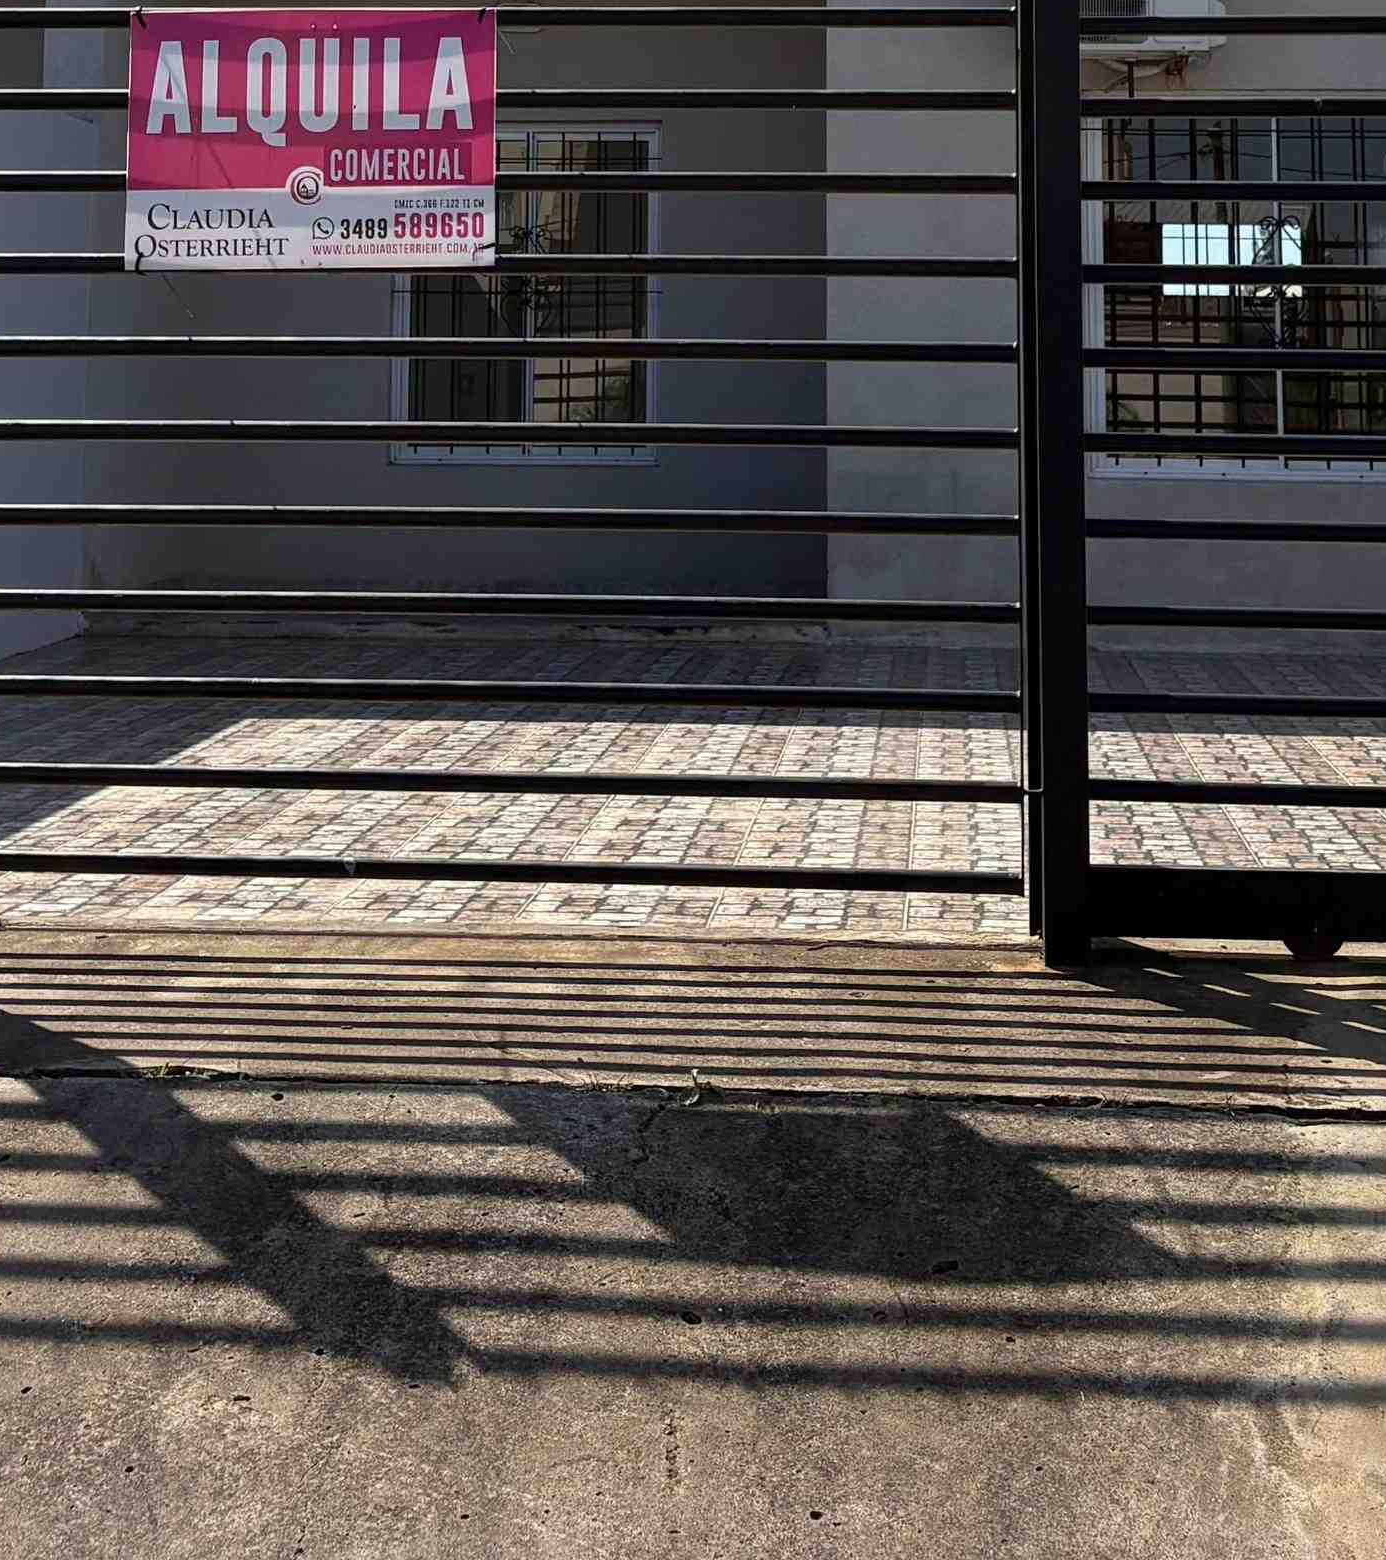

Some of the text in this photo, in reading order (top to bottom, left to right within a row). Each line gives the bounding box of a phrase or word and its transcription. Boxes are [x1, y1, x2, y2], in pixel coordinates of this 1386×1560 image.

[145, 36, 474, 147] ALQUILA
[329, 147, 466, 183] COMERCIAL
[147, 203, 276, 231] CLAUDIA
[340, 212, 485, 240] 3489 589650
[133, 234, 290, 258] OSTERRIEHT
